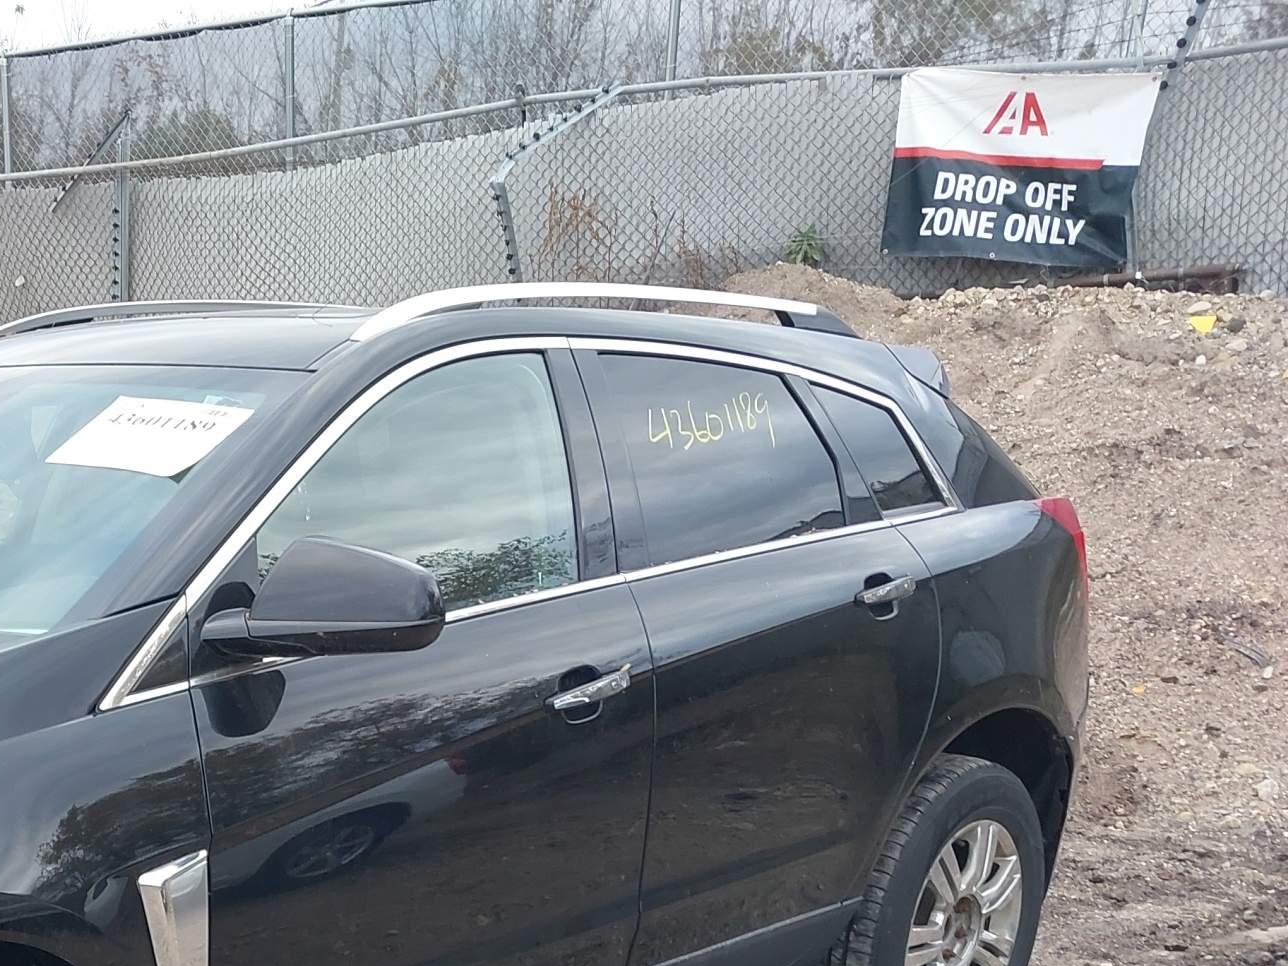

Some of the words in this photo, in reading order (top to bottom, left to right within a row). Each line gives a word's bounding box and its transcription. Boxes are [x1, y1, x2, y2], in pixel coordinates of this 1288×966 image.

[933, 171, 1016, 204] DROP
[1024, 181, 1077, 212] OFF
[919, 206, 997, 239] ZONE
[1003, 213, 1086, 245] ONLY
[648, 391, 776, 450] 43601189
